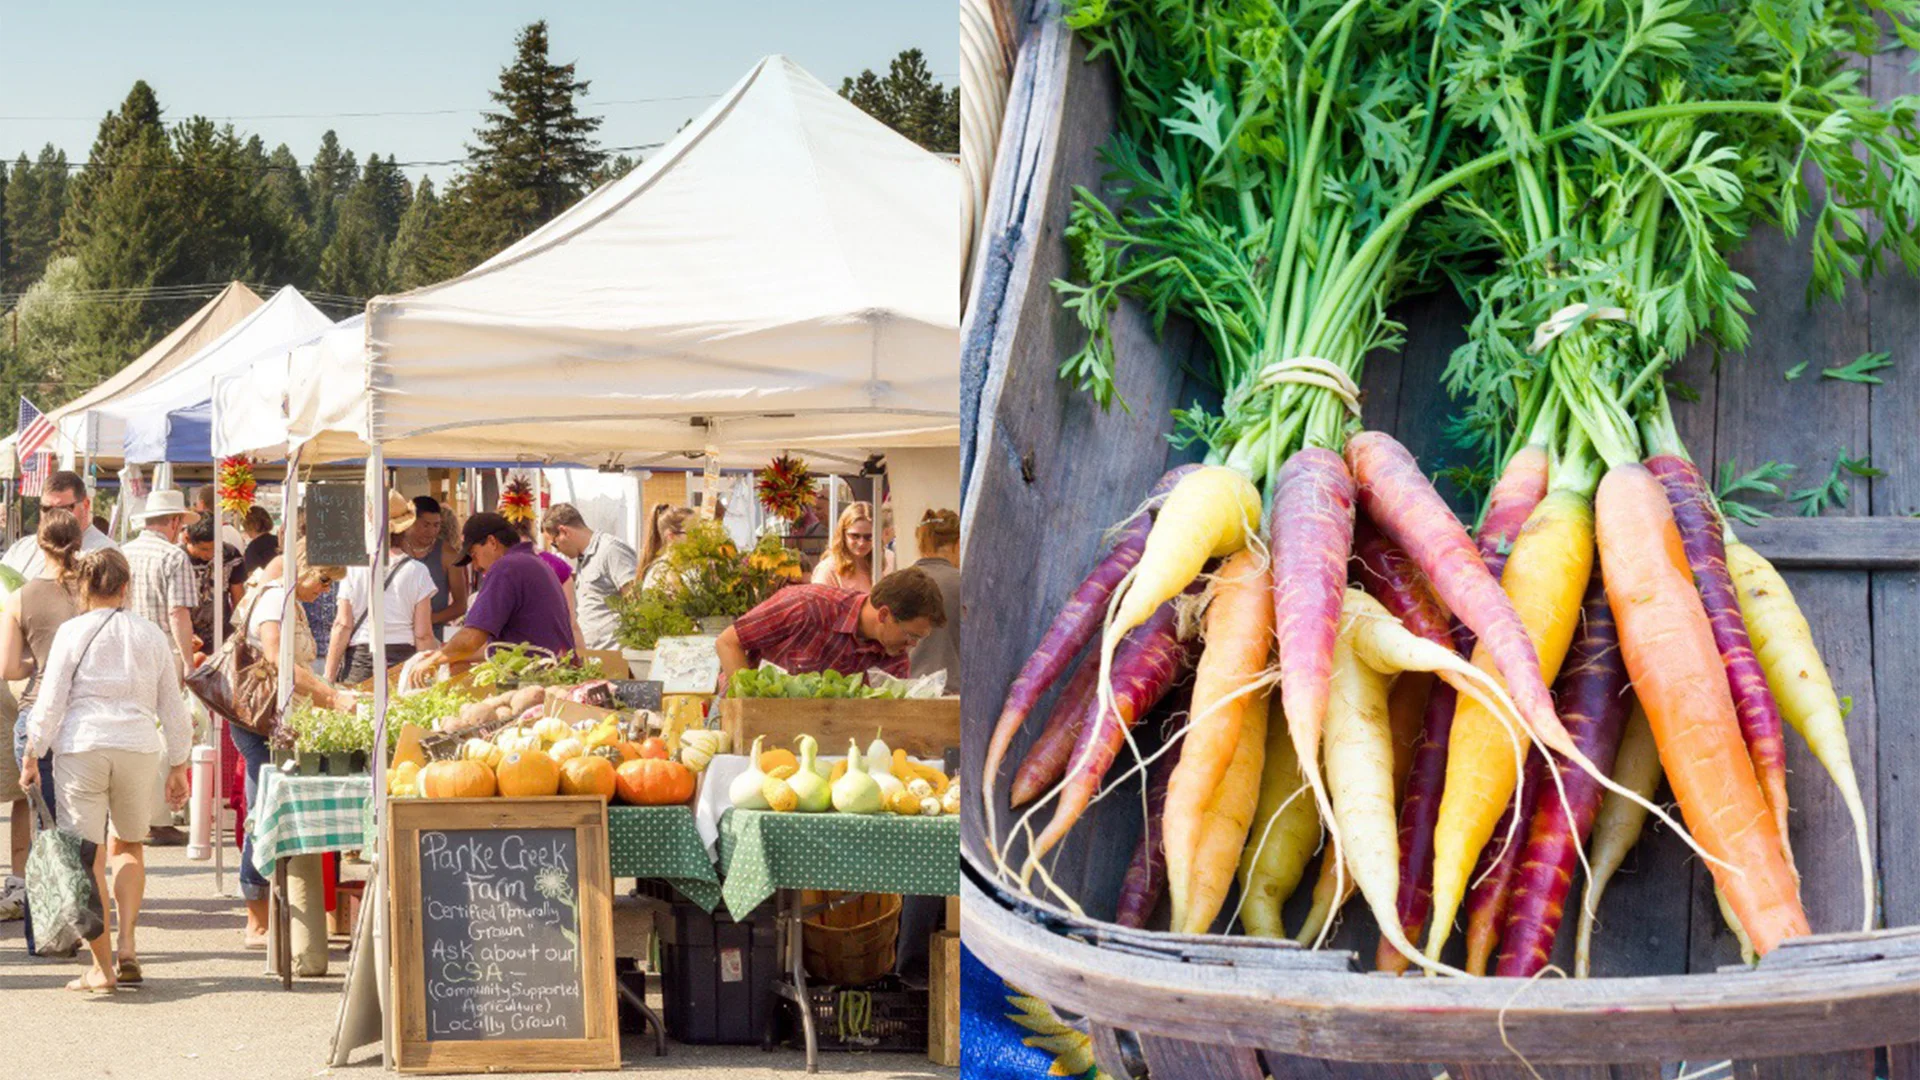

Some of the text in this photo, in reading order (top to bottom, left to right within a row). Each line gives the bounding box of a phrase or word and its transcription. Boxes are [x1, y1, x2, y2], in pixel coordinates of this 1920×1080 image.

[421, 831, 569, 875] Parke Creek
[462, 872, 528, 902] Farm
[431, 938, 575, 962] Ask about our
[428, 979, 580, 1003] (Community Supported
[462, 997, 551, 1018] Agriculture)
[433, 1009, 568, 1037] Locally Grown
